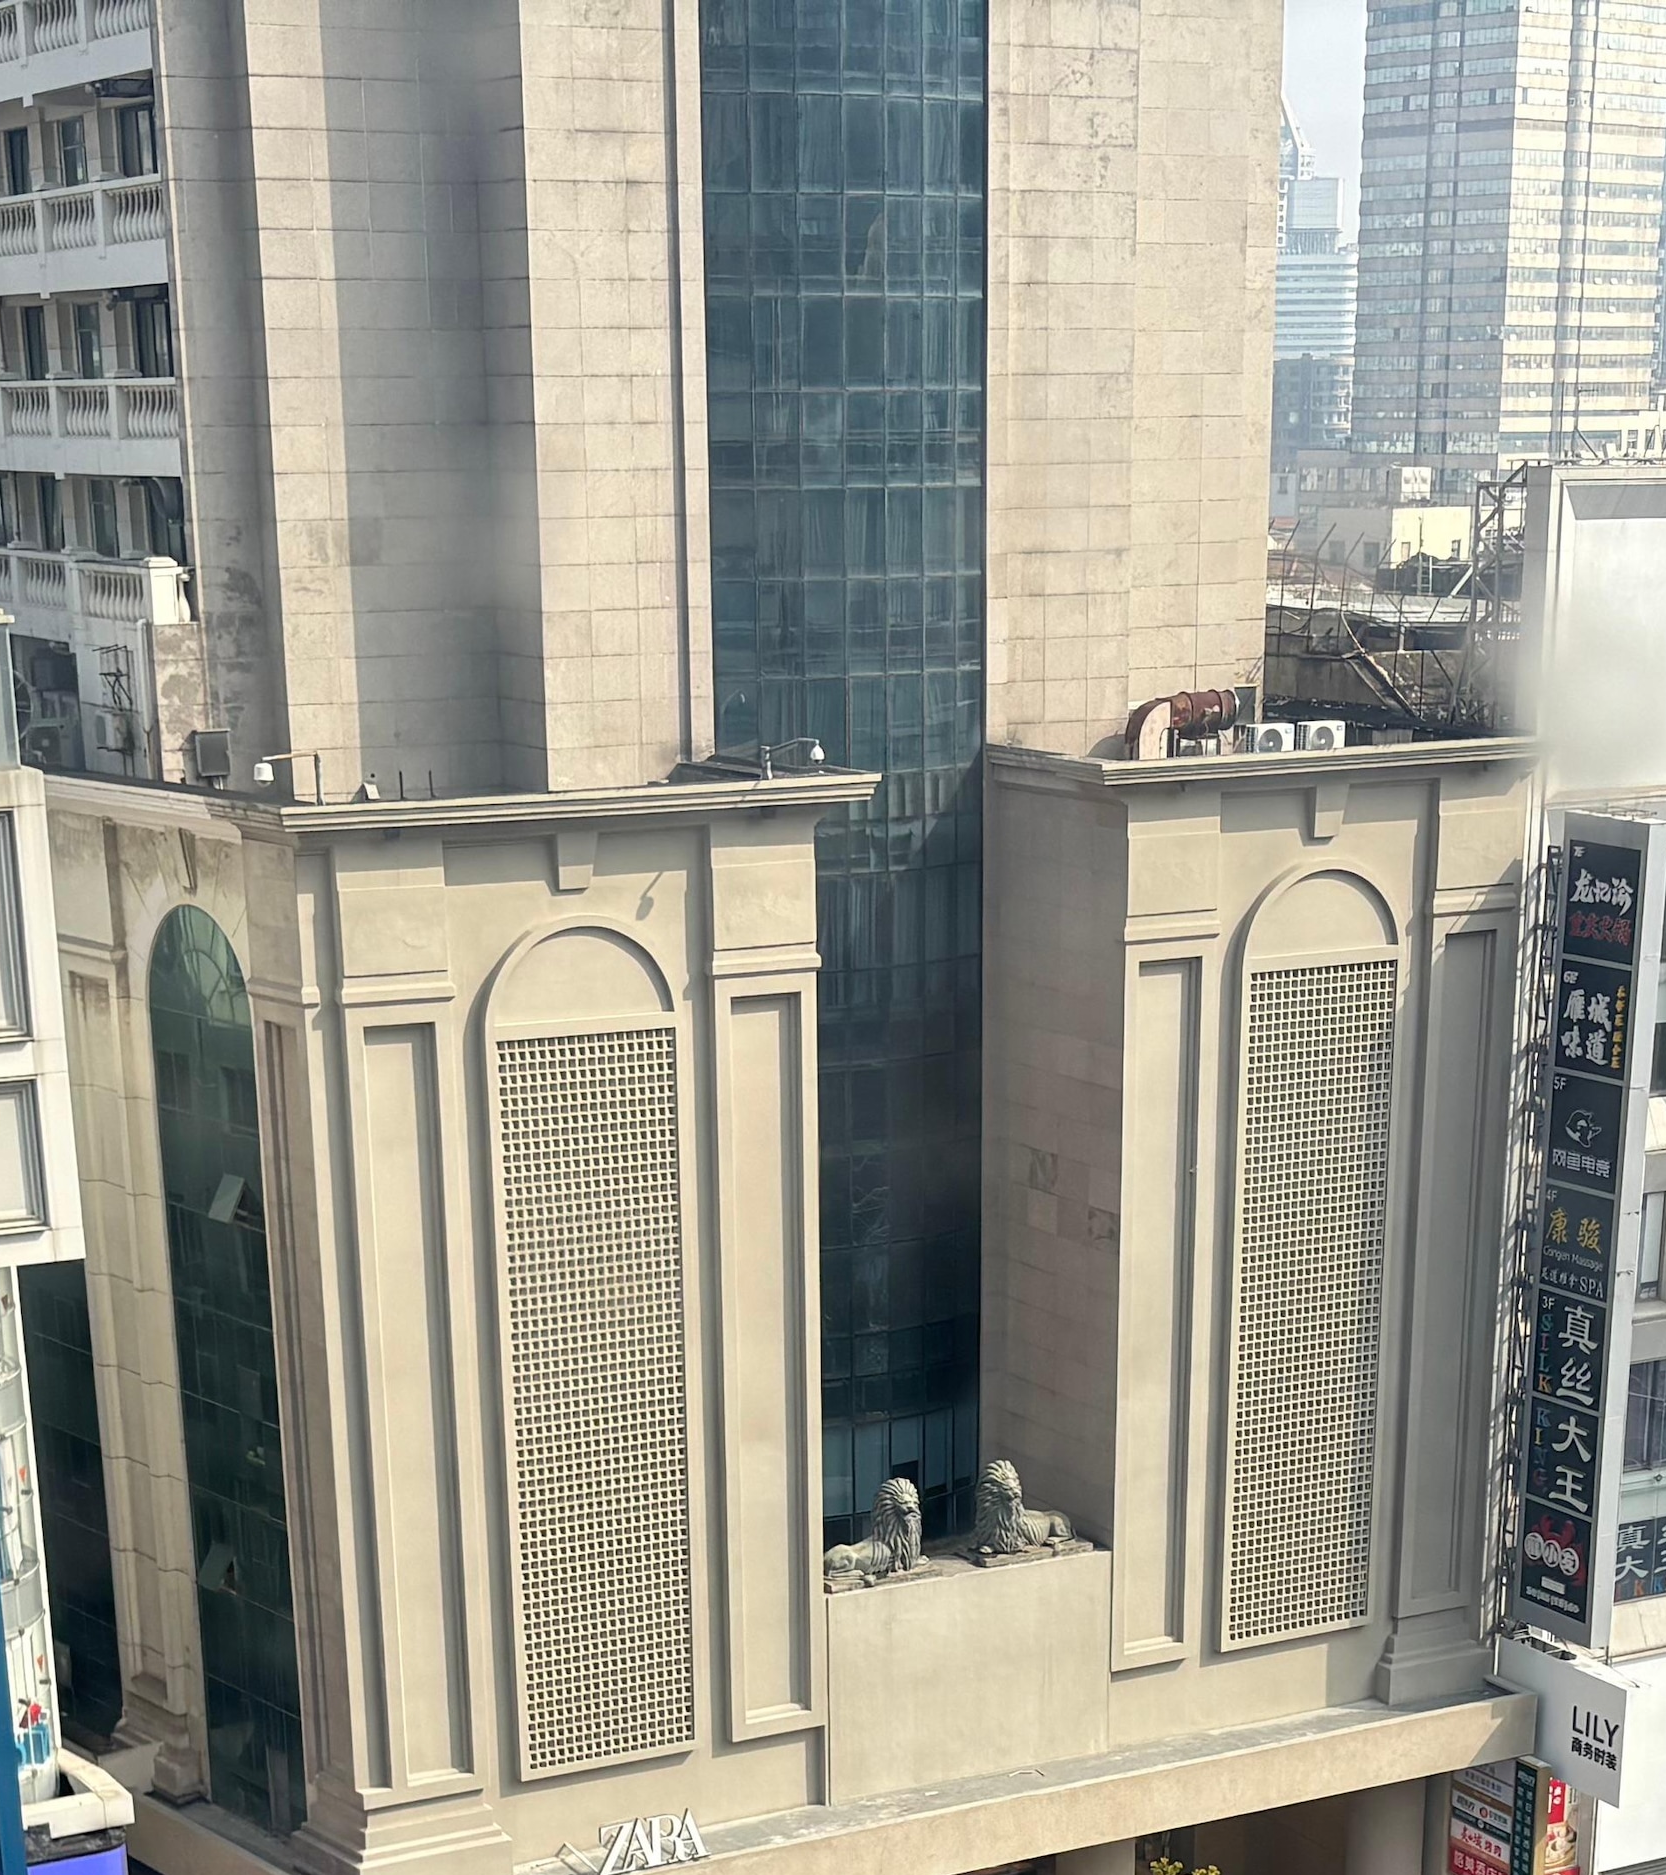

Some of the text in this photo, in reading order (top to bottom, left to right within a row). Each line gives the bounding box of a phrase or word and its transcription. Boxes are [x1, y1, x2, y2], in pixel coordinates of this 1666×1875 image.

[1553, 1076, 1567, 1090] 5F
[1546, 1189, 1558, 1201] 4F
[1546, 1207, 1602, 1254] 康骏
[1571, 1251, 1604, 1273] Massage
[1579, 1276, 1604, 1299] SPA
[1541, 1296, 1555, 1310] 3F
[1538, 1313, 1554, 1394] SILK
[1572, 1705, 1620, 1748] LILY
[1570, 1736, 1618, 1771] 商务时装
